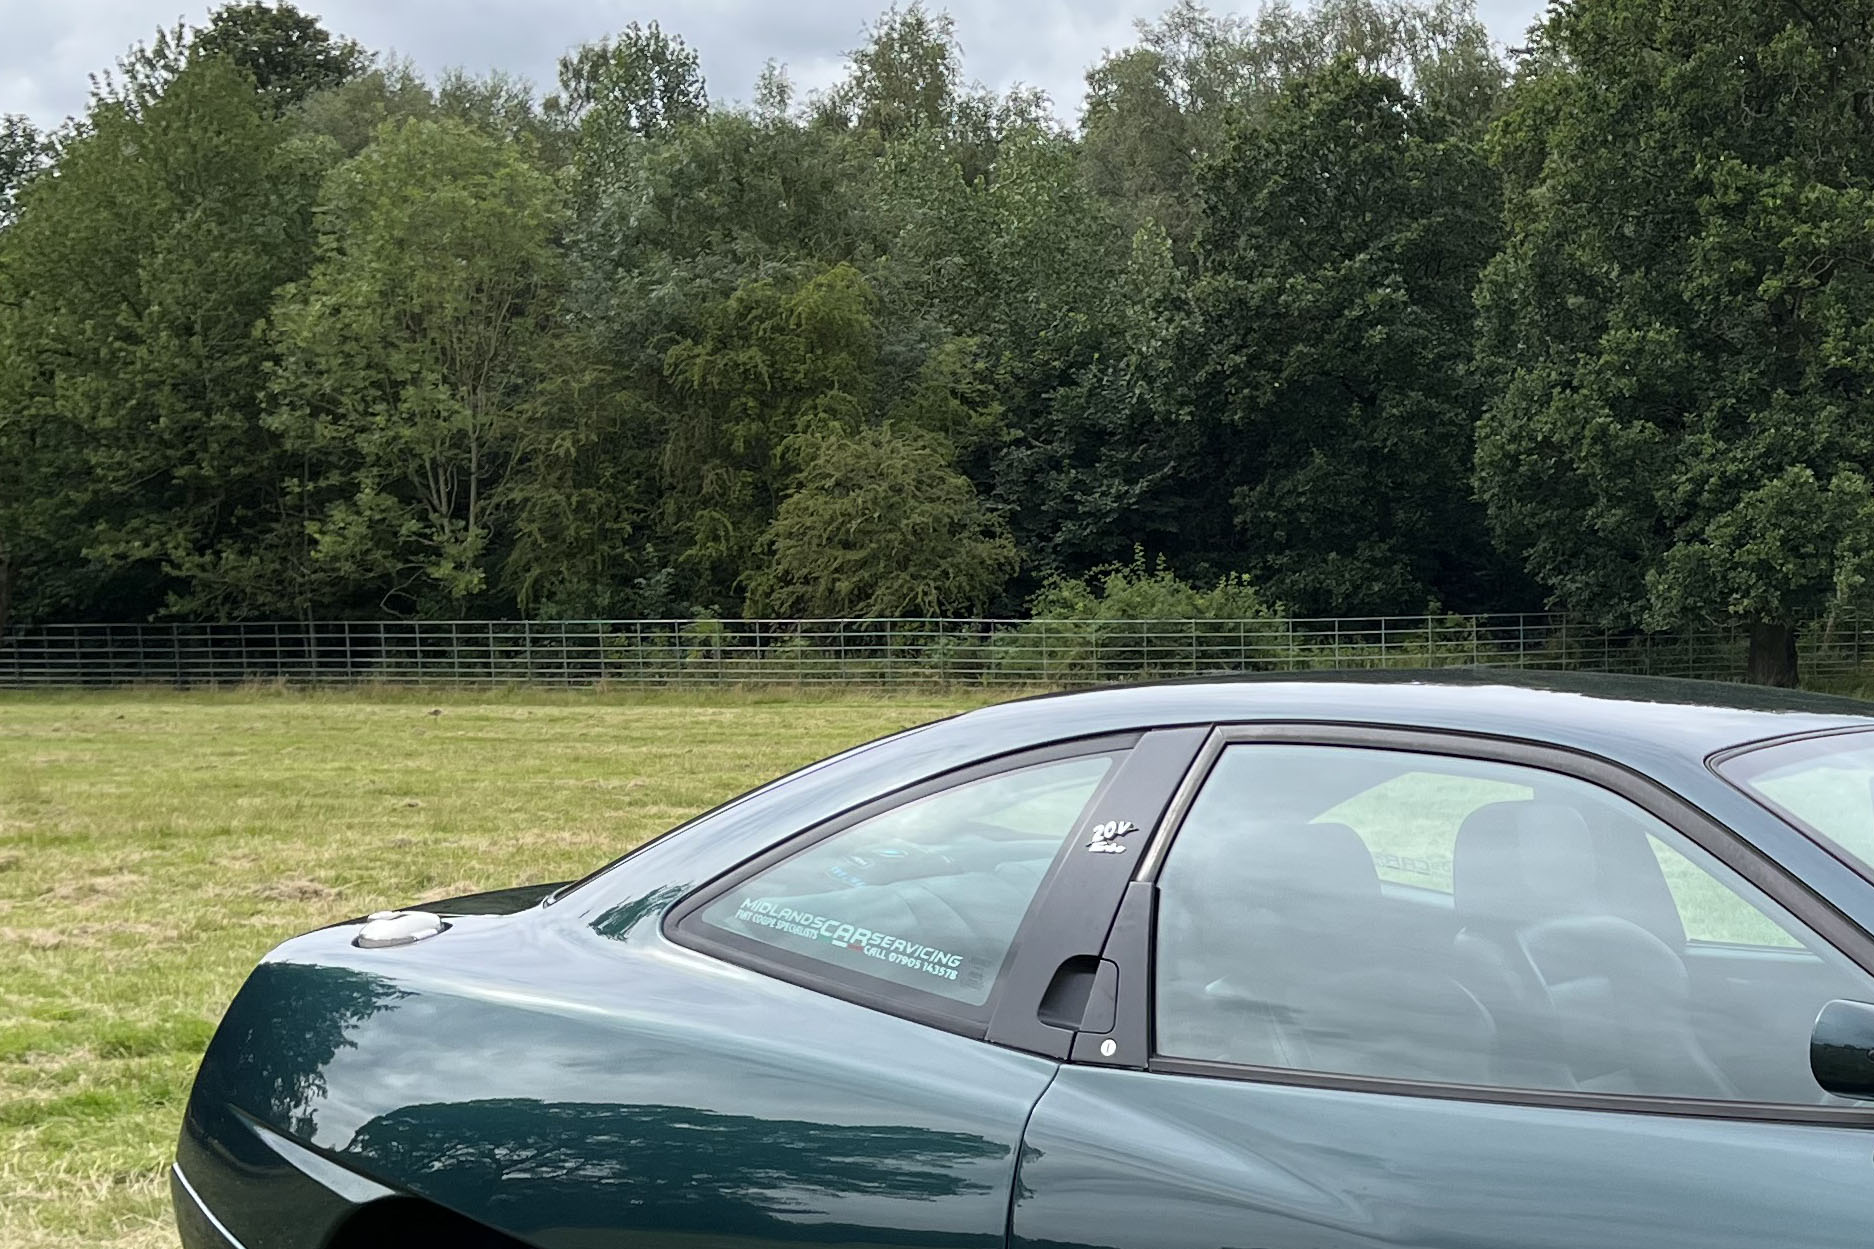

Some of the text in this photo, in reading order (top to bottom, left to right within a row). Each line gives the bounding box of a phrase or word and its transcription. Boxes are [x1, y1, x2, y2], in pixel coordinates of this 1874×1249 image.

[1091, 820, 1132, 842] 20V
[775, 920, 819, 940] SPECIALISTS
[863, 945, 886, 960] CALL
[888, 952, 922, 969] 07905
